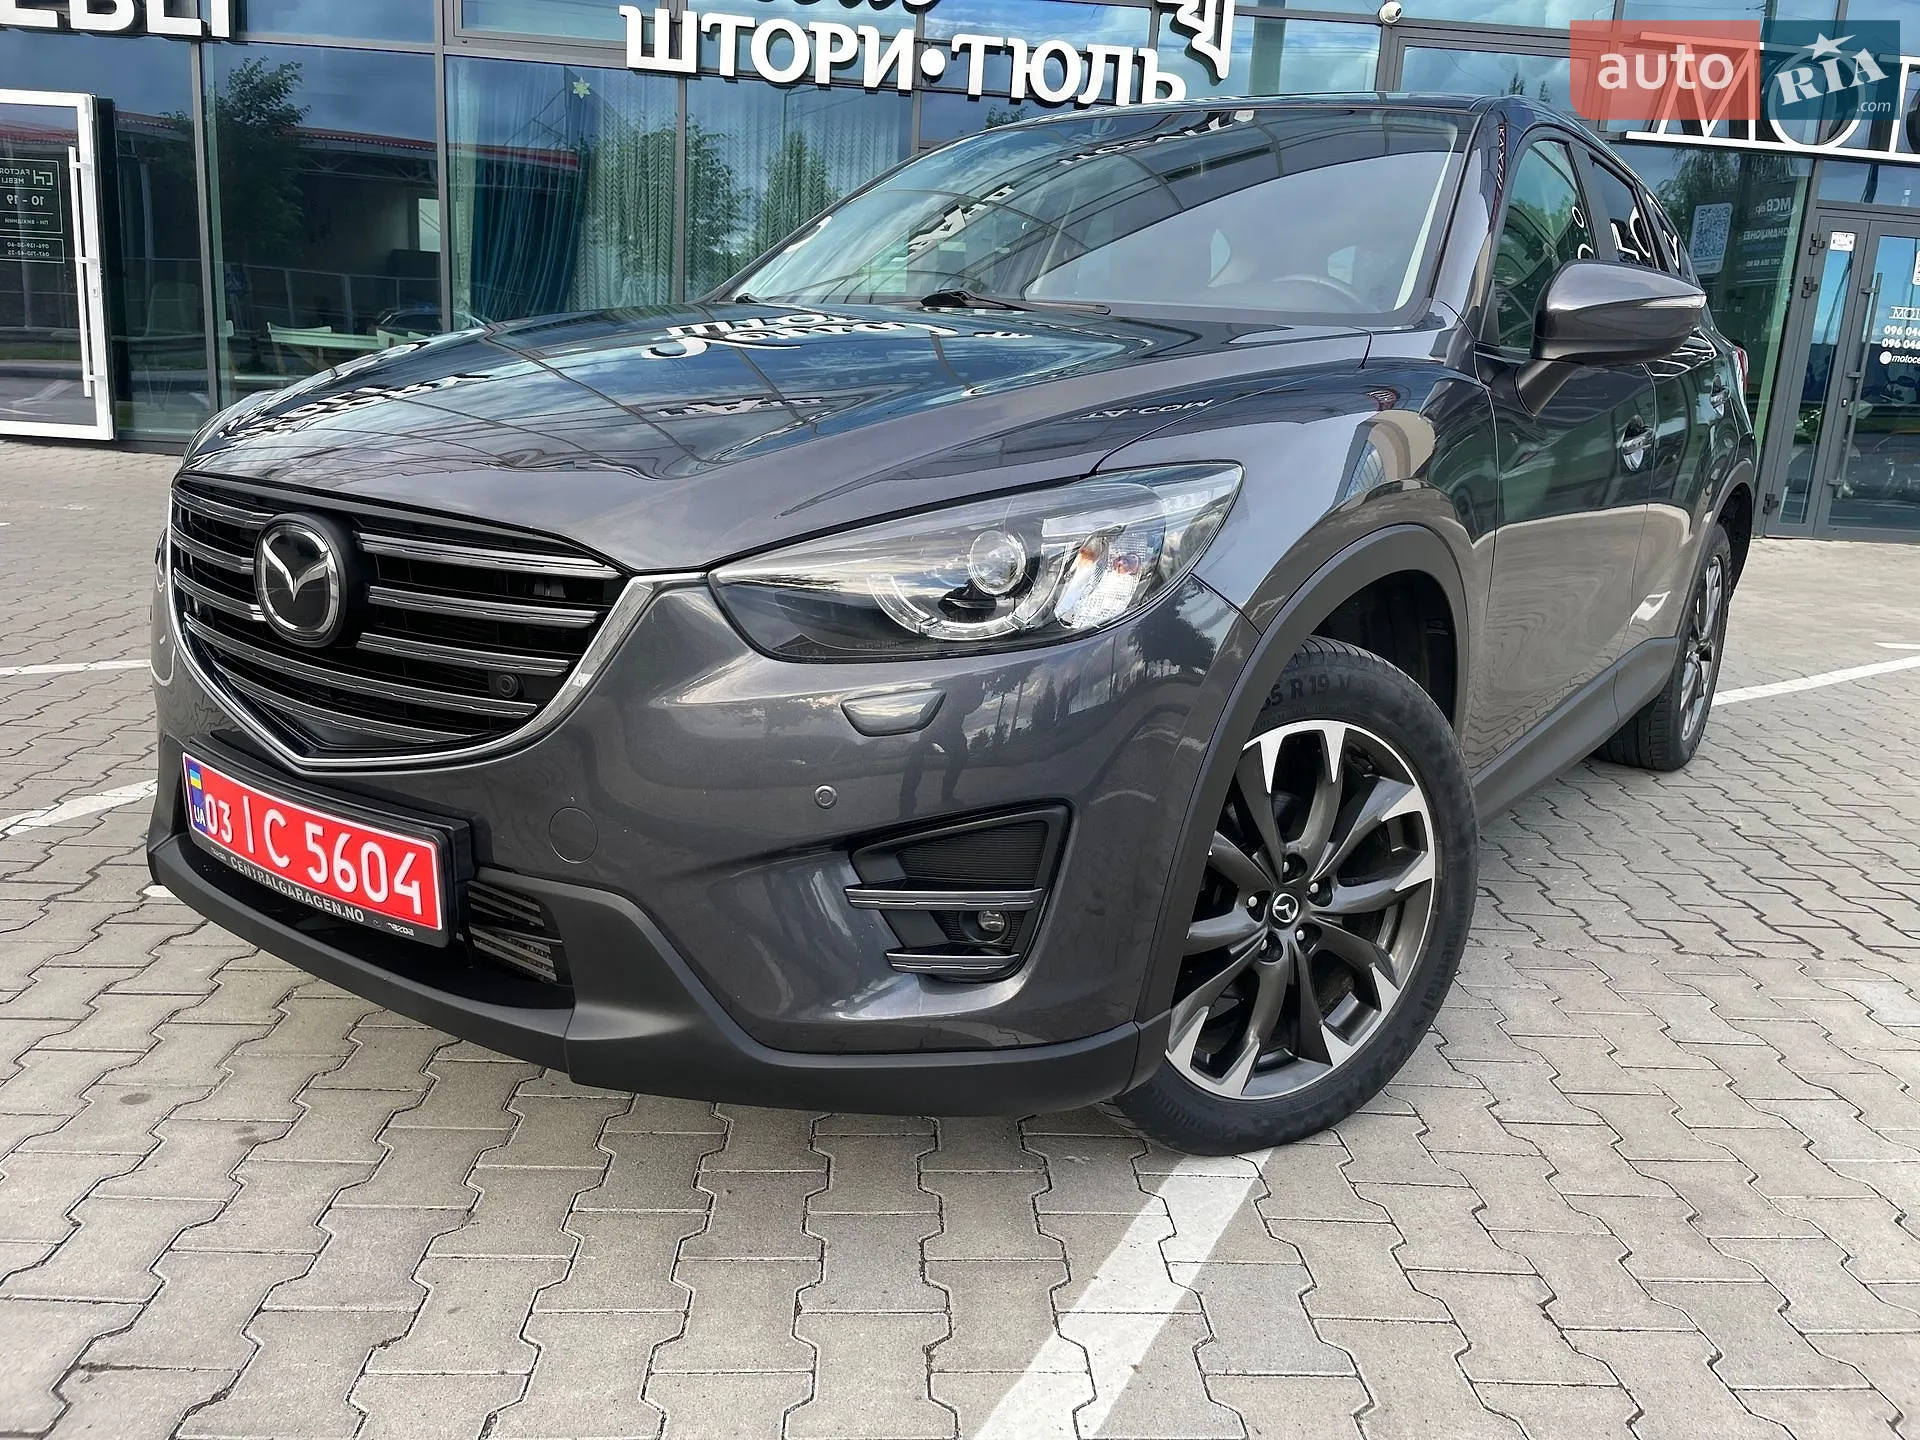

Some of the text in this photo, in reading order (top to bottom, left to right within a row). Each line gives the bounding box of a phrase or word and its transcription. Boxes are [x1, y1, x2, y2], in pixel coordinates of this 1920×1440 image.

[193, 803, 206, 827] UA
[205, 793, 234, 844] 03
[304, 820, 423, 916] 5604
[230, 856, 365, 923] CENTRALGARAGEN.NO
